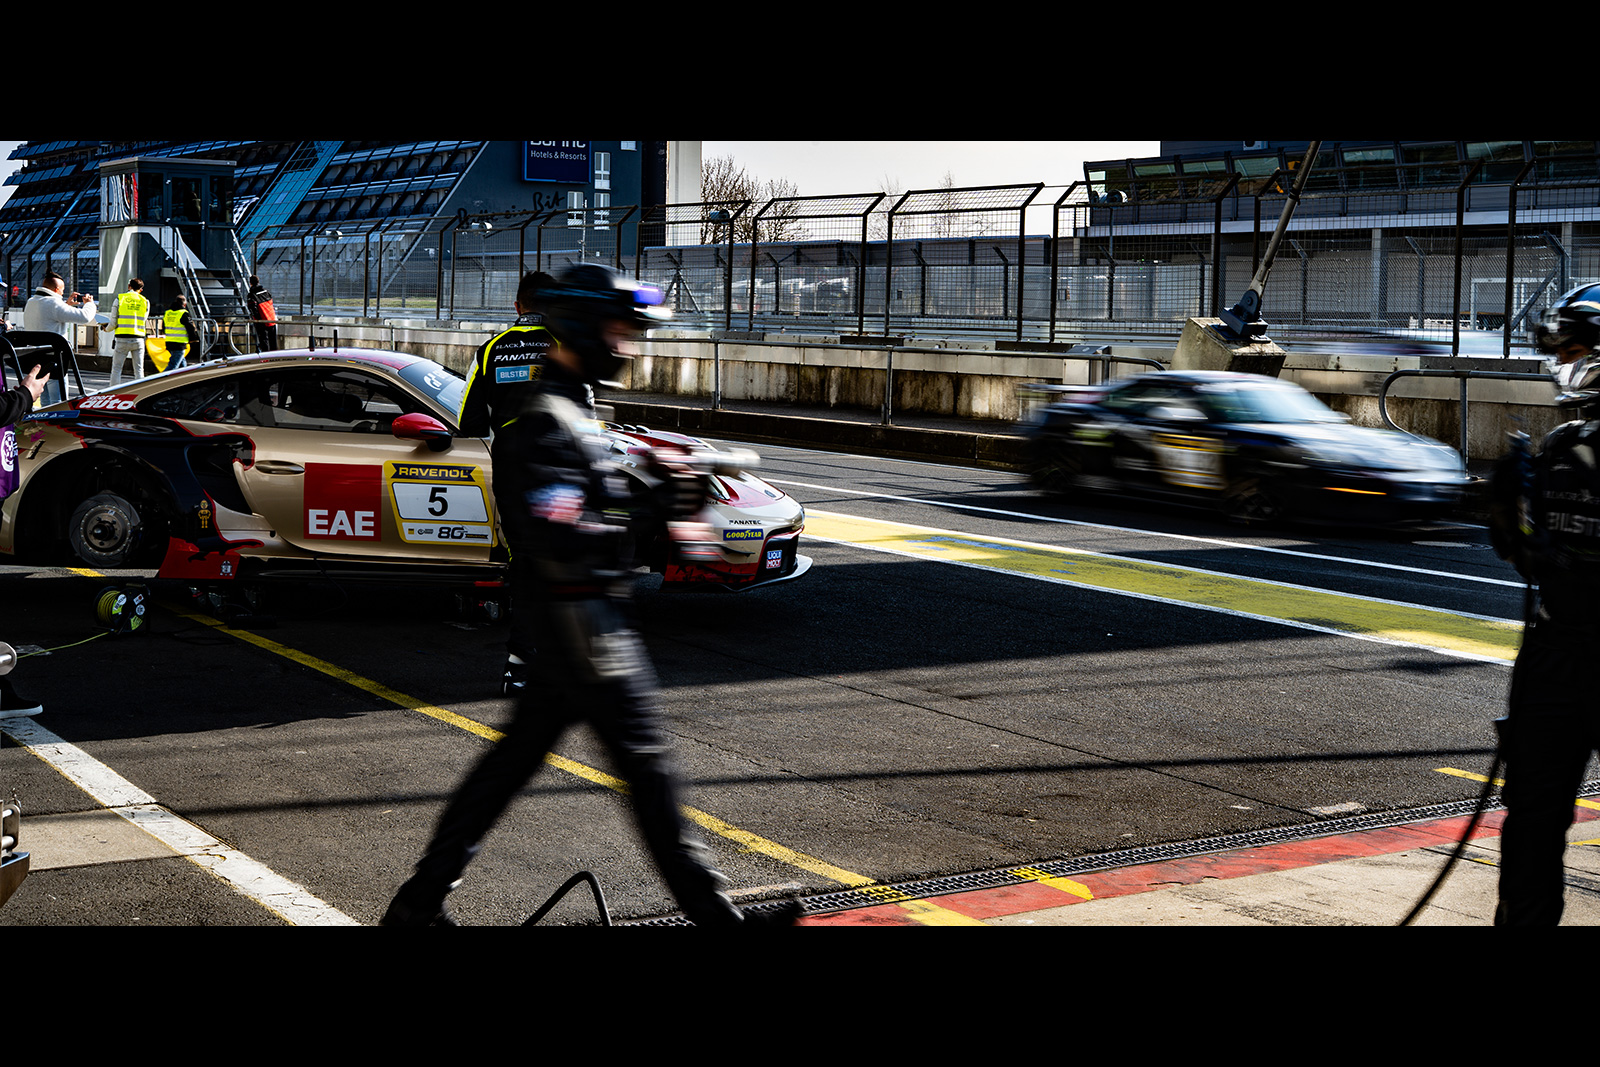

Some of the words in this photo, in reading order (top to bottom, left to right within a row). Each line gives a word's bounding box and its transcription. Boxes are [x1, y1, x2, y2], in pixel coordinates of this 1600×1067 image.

[530, 150, 553, 159] Hotels
[554, 151, 559, 159] &
[560, 151, 586, 161] Resorts
[533, 190, 565, 212] Bit
[500, 370, 529, 379] BILSTEIN
[79, 399, 136, 410] auto
[398, 466, 469, 479] RAVENOL
[427, 486, 449, 517] 5
[308, 508, 375, 537] EAE
